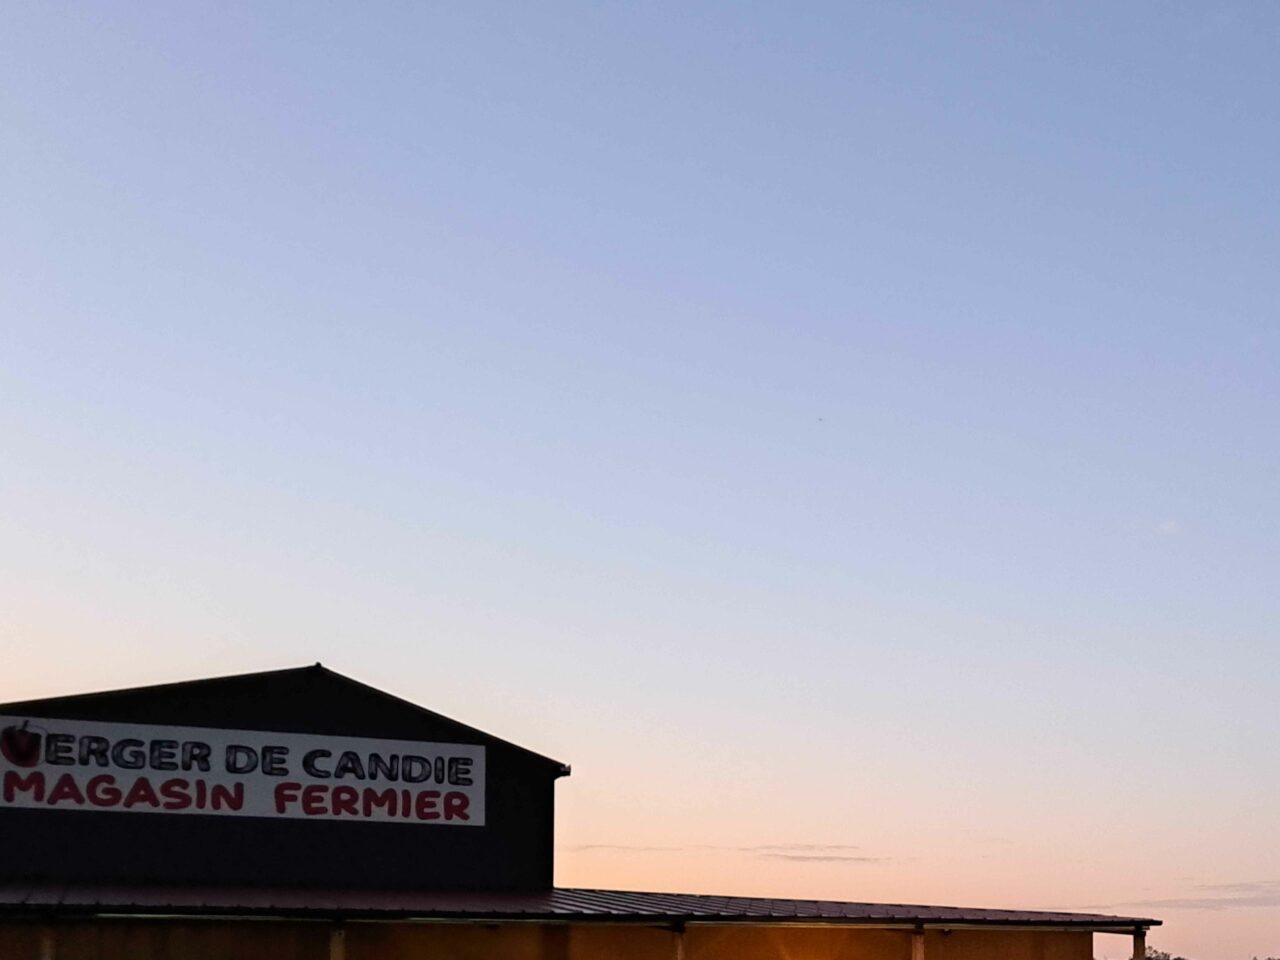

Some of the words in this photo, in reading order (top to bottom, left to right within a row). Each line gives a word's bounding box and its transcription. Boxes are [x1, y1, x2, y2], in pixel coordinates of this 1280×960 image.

[226, 745, 288, 776] DE
[302, 749, 474, 787] CANDIE
[4, 770, 244, 811] MAGASIN
[274, 782, 470, 821] FERMIER
